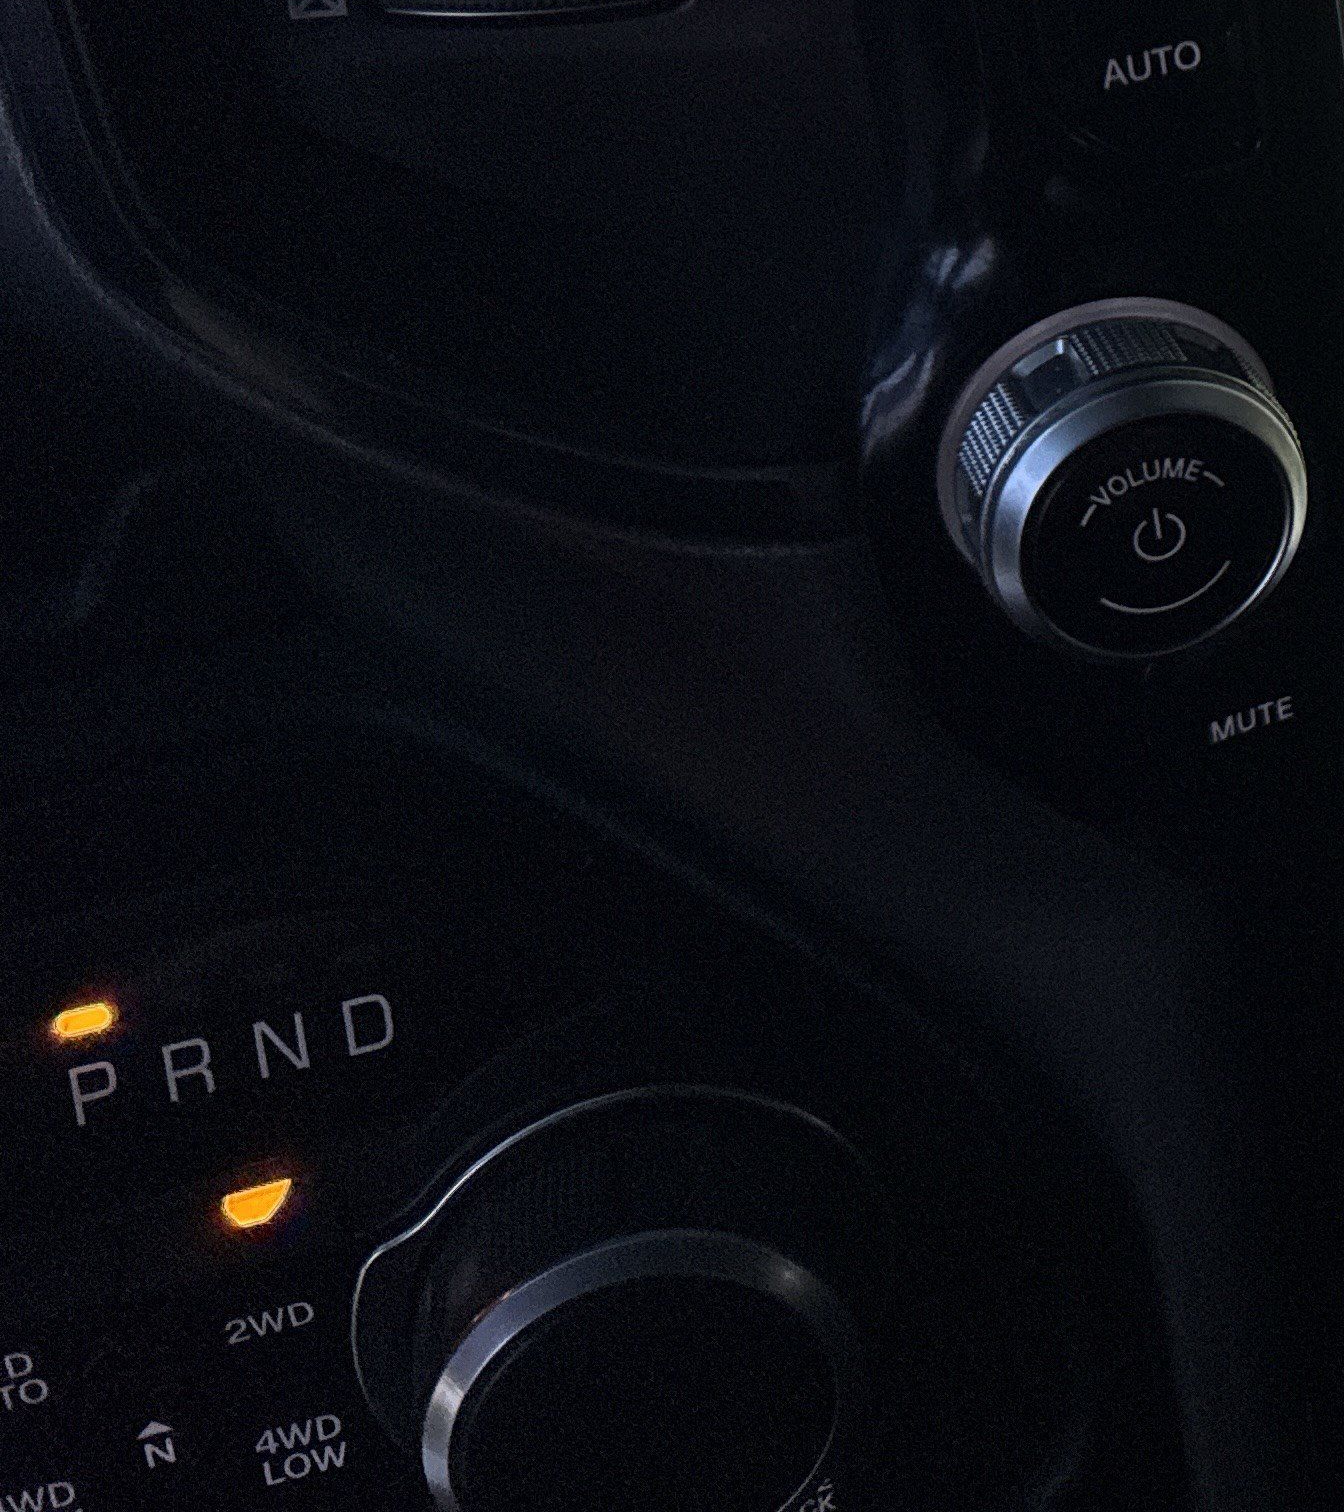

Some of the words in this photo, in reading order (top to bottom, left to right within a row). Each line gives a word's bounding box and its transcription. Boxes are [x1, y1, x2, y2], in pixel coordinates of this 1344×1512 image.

[1103, 40, 1201, 90] AUTO
[1090, 457, 1205, 508] VOLUME
[1209, 694, 1295, 745] MUTE
[68, 1061, 118, 1126] P
[161, 1037, 217, 1102] R
[253, 1012, 311, 1079] N
[342, 994, 395, 1056] D
[224, 1301, 315, 1346] 2WD
[143, 1436, 178, 1470] N
[254, 1413, 343, 1455] 4WD
[263, 1440, 348, 1487] LOW
